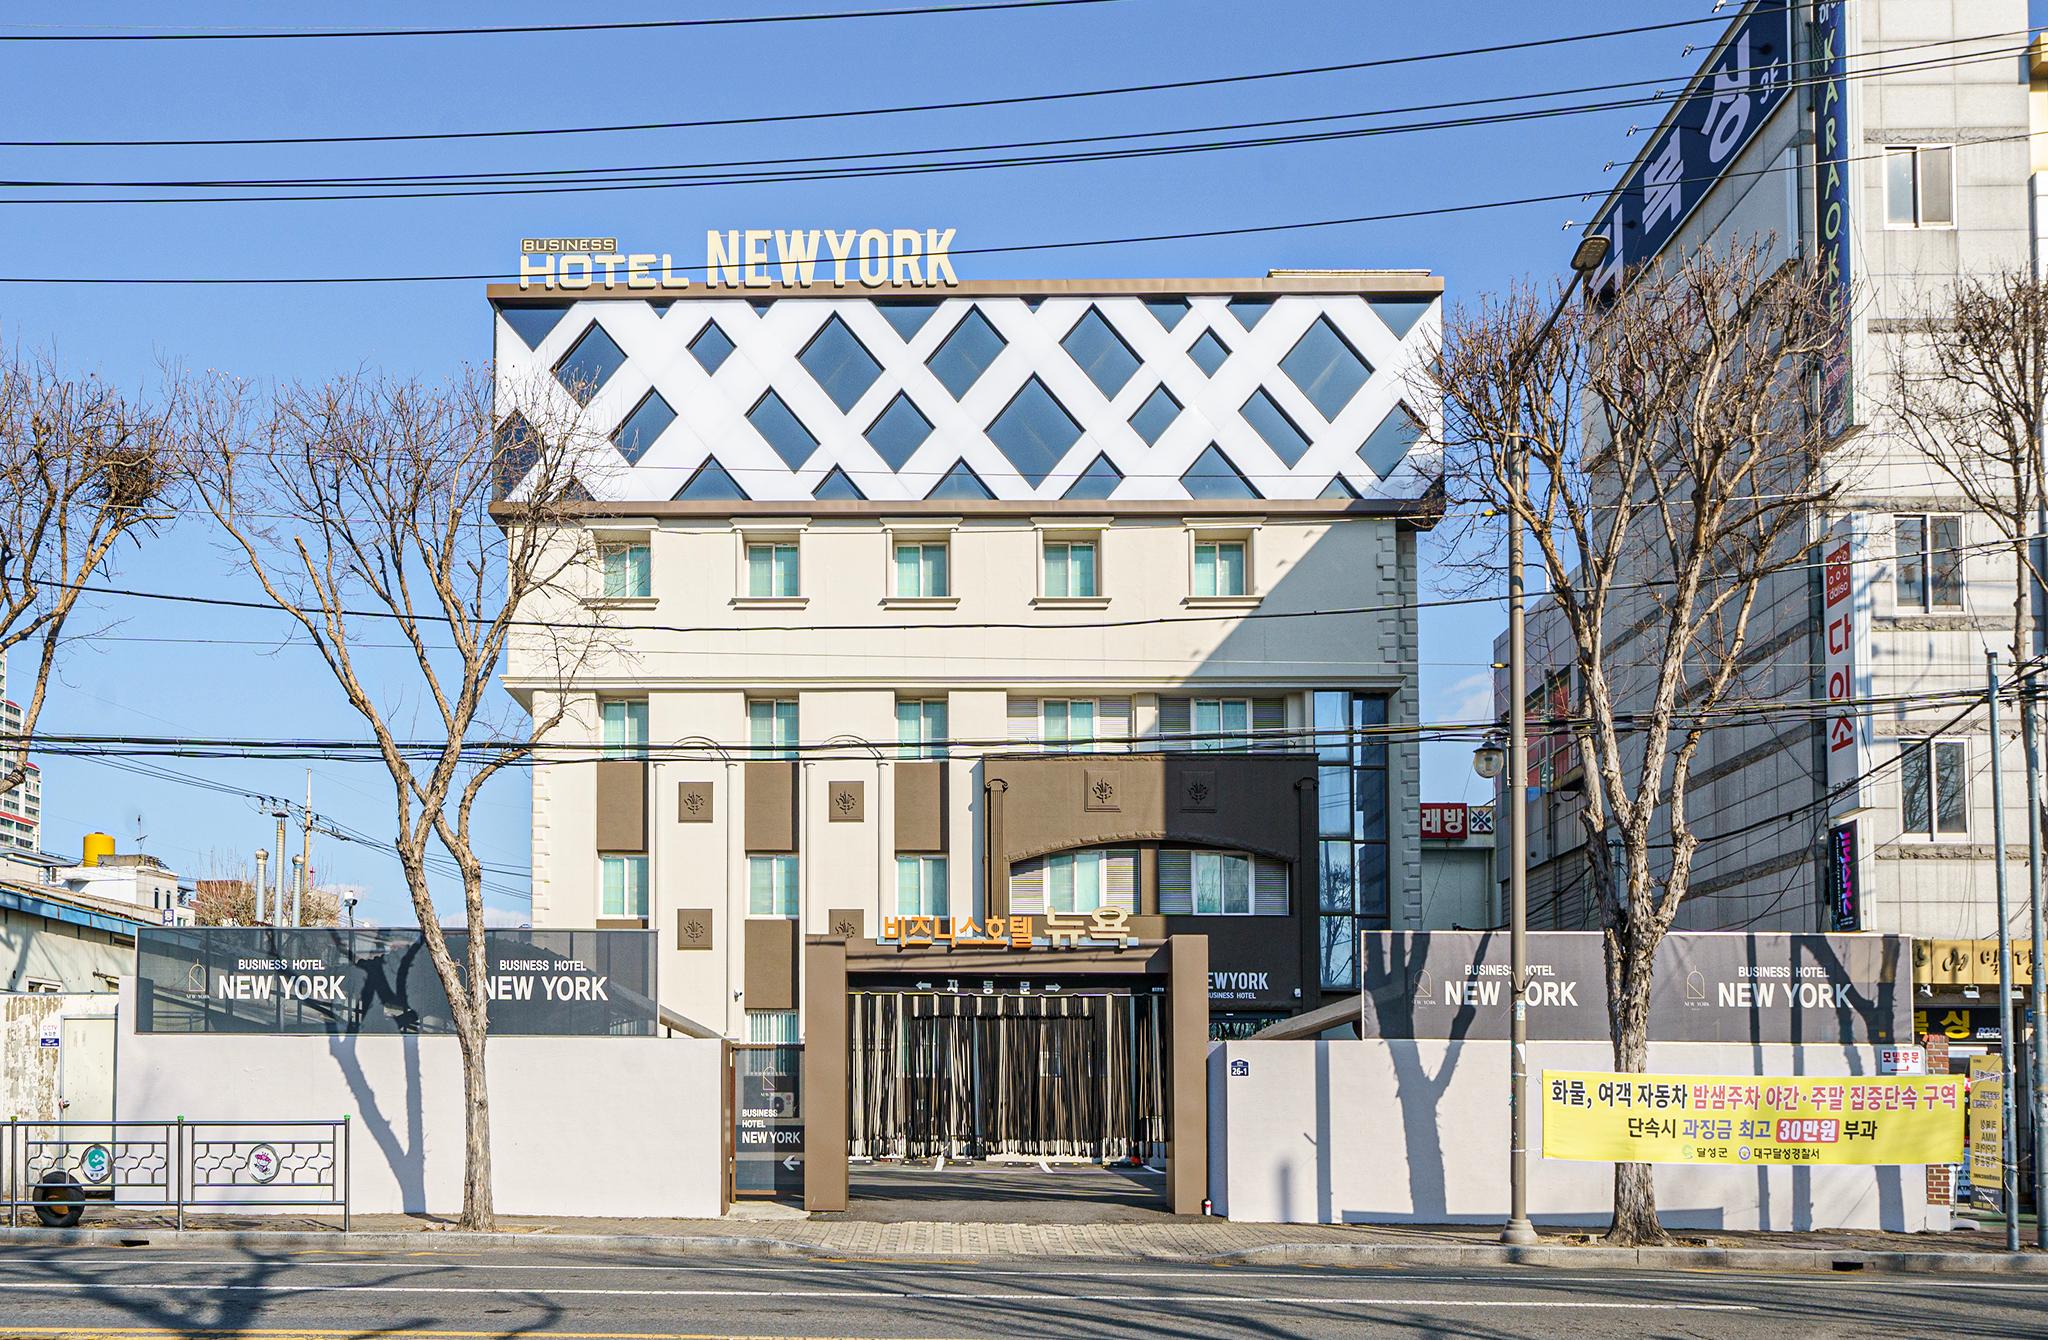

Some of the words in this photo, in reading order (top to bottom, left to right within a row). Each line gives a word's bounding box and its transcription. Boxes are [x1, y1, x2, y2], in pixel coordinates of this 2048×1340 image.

[1823, 28, 1842, 326] KARAOKE
[522, 239, 615, 252] BUSINESS
[519, 254, 690, 289] HOTEL
[1829, 581, 1849, 600] daiso
[1829, 613, 1854, 752] 다이소
[883, 915, 1034, 948] 비즈니스호텔
[1043, 905, 1132, 949] 뉴욕
[238, 959, 288, 970] BUSINESS
[292, 959, 325, 970] HOTEL
[499, 959, 550, 971] BUSINESS
[554, 960, 587, 972] HOTEL
[1738, 966, 1791, 978] BUSINESS
[1795, 967, 1829, 978] HOTEL
[218, 975, 273, 1000] NEW
[279, 975, 346, 1000] YORK
[485, 976, 535, 1001] NEW
[540, 976, 609, 1001] YORK
[1207, 991, 1234, 999] USINESS
[1444, 981, 1501, 1006] NEW
[1508, 981, 1579, 1007] ORK
[1718, 982, 1775, 1008] NEW
[1782, 983, 1854, 1009] YORK
[1232, 1067, 1247, 1076] 26-1
[1551, 1080, 1592, 1108] 화물,
[1599, 1083, 1632, 1108] 여객
[1638, 1084, 1688, 1109] 자동차
[1693, 1085, 1761, 1110] 밤샘주차
[1850, 1086, 1917, 1111] 집중단속
[1923, 1085, 1957, 1110] 구역
[742, 1109, 778, 1117] BUSINESS
[742, 1120, 766, 1128] HOTEL
[1628, 1118, 1677, 1138] 단속시
[1682, 1119, 1732, 1140] 과징금
[1738, 1120, 1771, 1140] 최고
[1779, 1120, 1837, 1141] 30만원
[1843, 1121, 1878, 1140] 부과
[741, 1131, 768, 1144] NEW
[769, 1131, 801, 1144] YORK
[1696, 1147, 1728, 1158] 달성군
[1754, 1148, 1820, 1160] 대구달성경찰서
